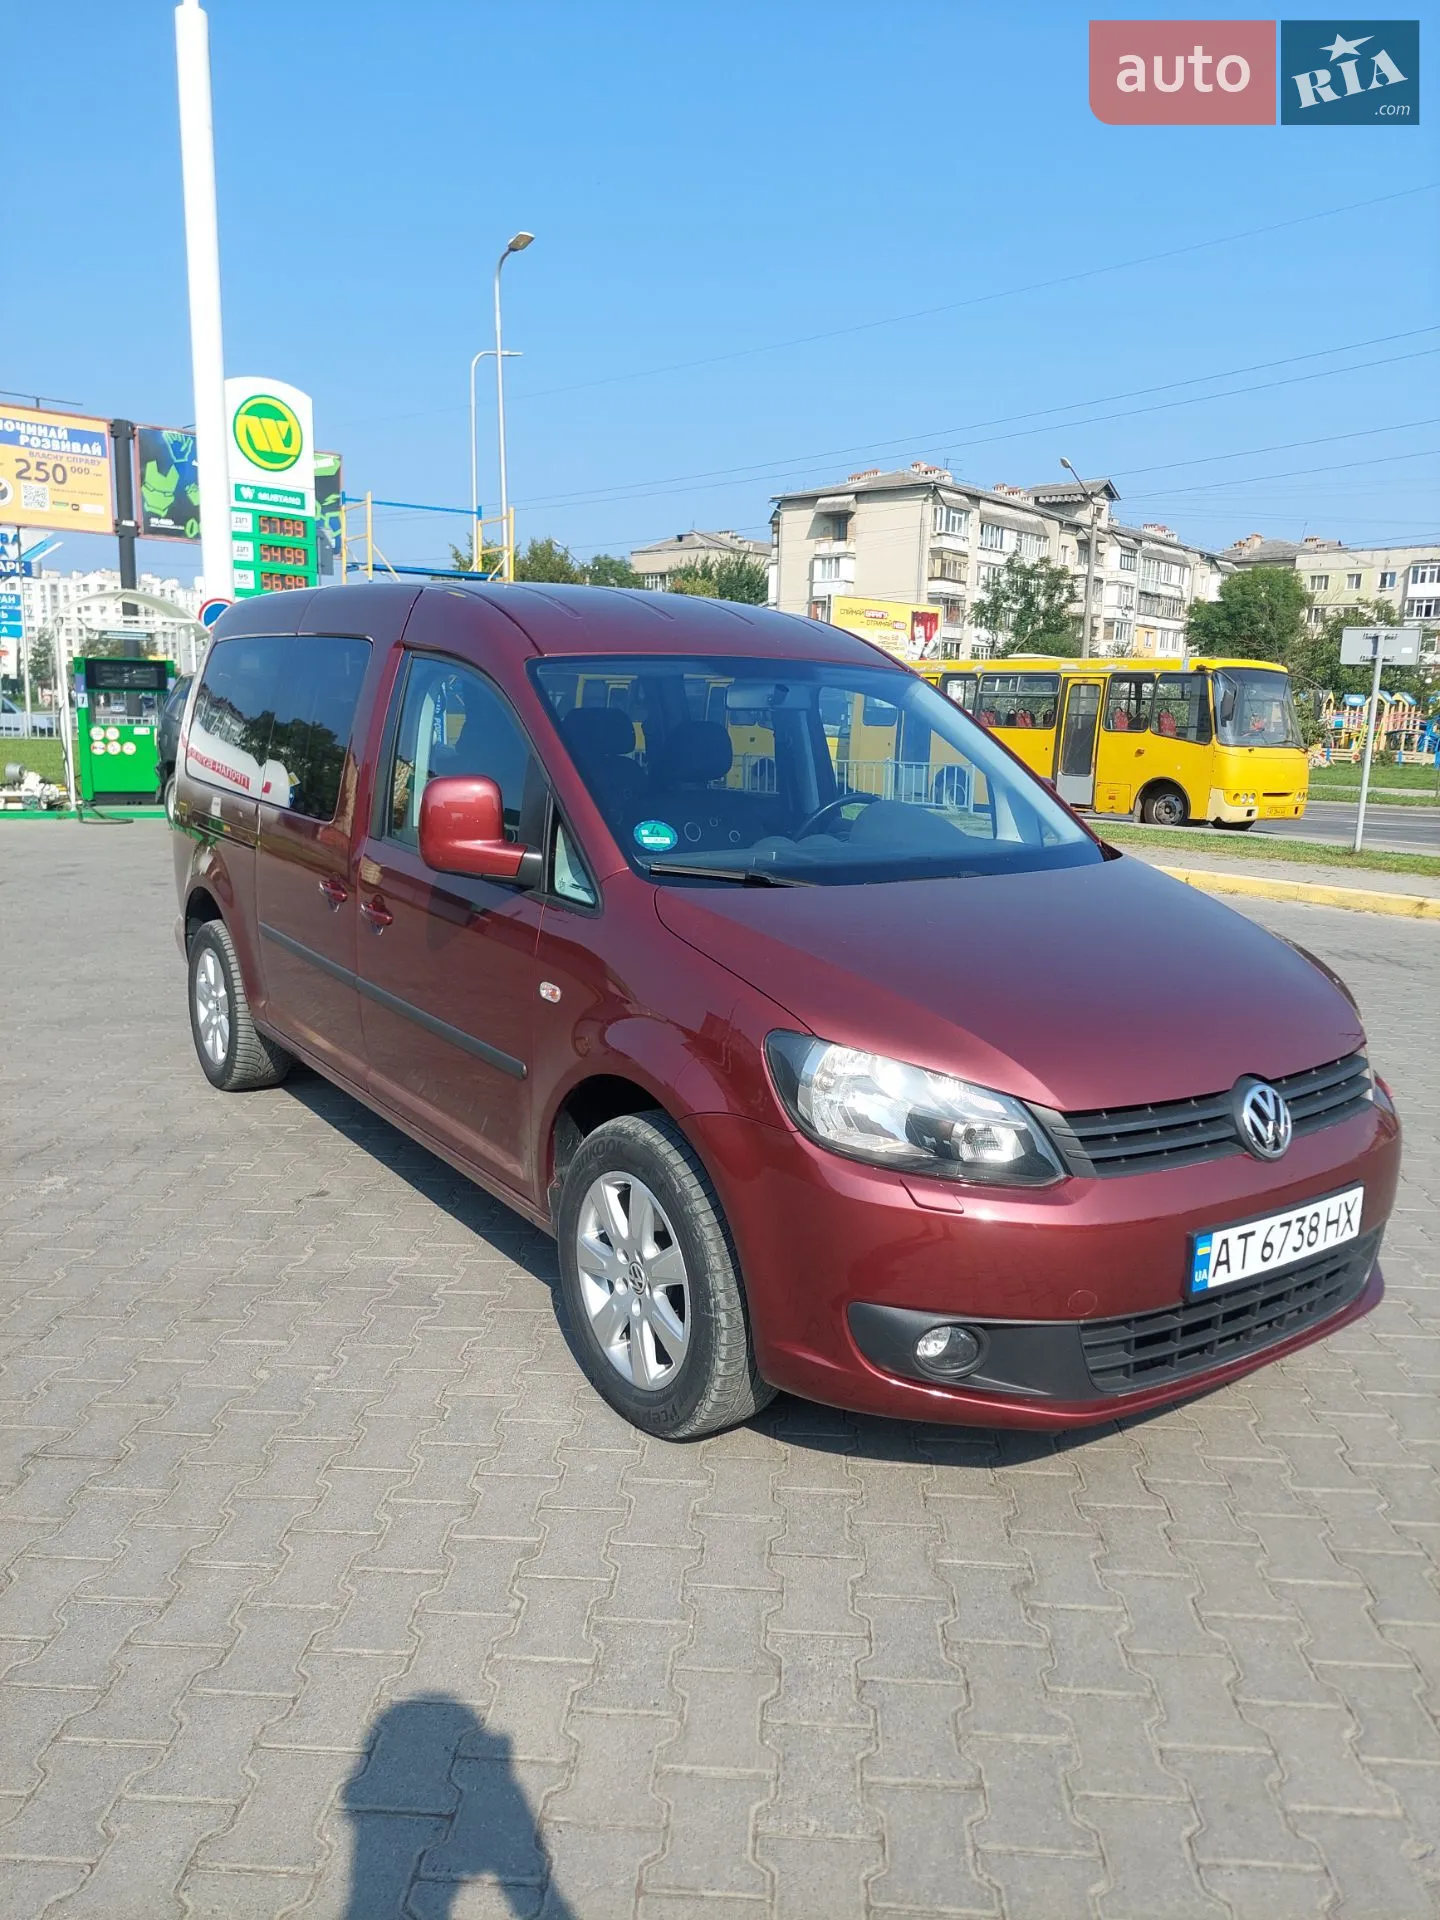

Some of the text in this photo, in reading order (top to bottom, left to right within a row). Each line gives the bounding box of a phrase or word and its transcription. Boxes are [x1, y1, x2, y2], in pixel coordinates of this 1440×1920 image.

[19, 434, 102, 456] РОЗВИВАЙ
[14, 458, 68, 486] 250
[260, 515, 305, 539] 57.99
[261, 543, 306, 566] 54.99
[262, 572, 306, 592] 56.99
[1212, 1197, 1358, 1278] AT 6738 HX
[1194, 1268, 1208, 1282] UA
